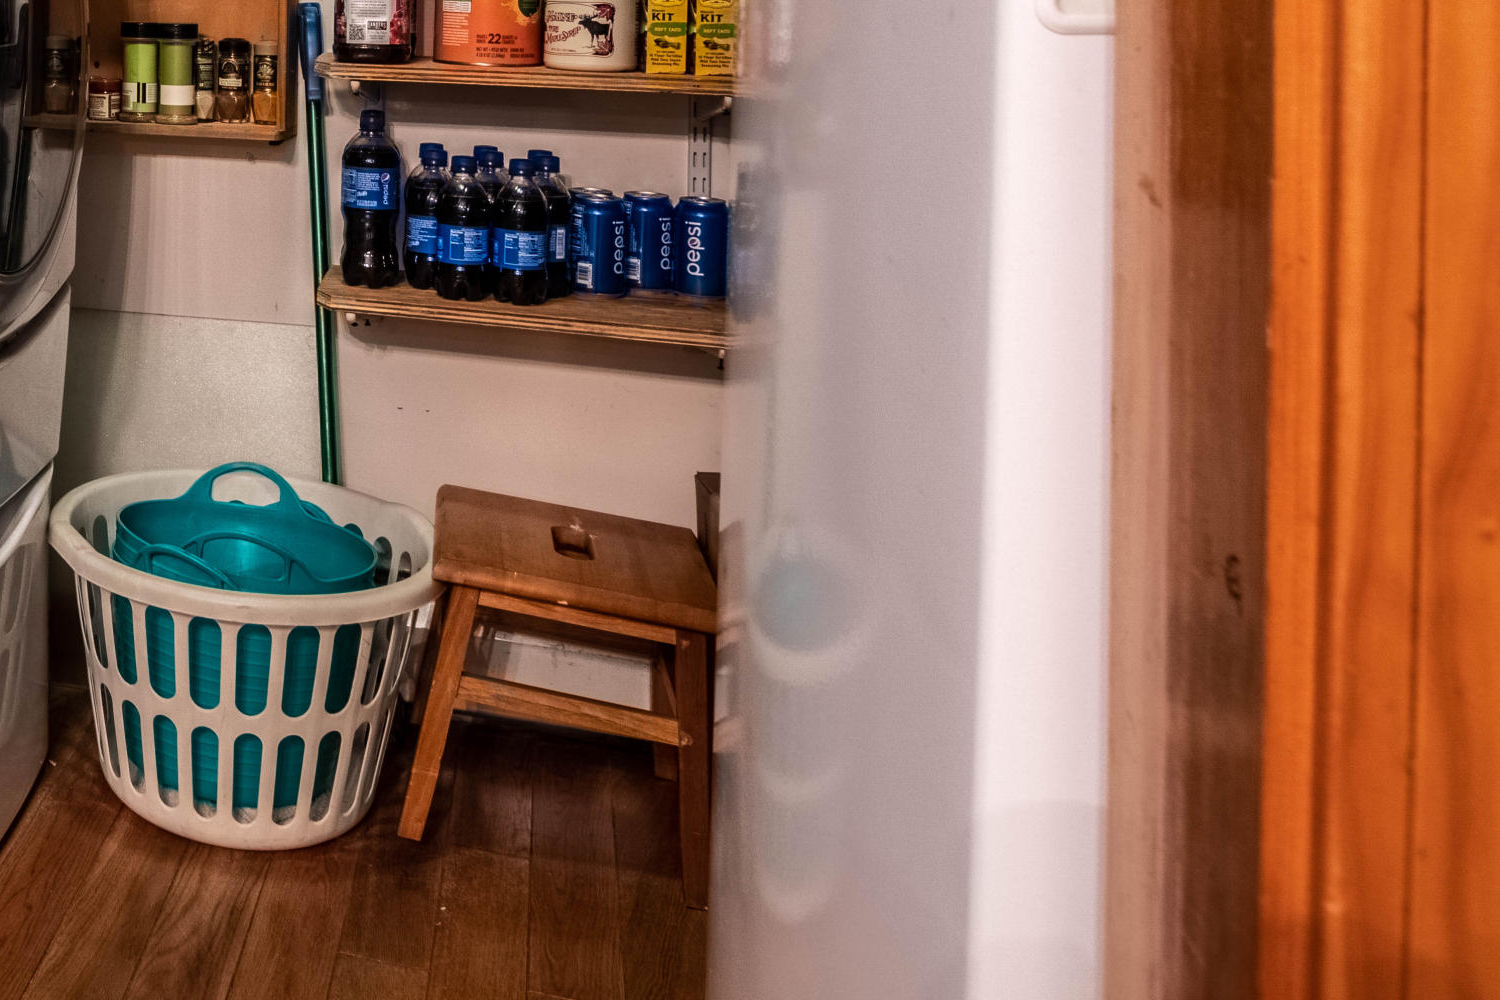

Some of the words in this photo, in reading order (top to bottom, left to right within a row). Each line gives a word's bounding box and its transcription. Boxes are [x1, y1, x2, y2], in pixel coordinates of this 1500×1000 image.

[652, 13, 675, 21] KIT
[700, 14, 723, 22] KIT
[488, 33, 501, 44] 22
[612, 221, 625, 274] pepsi
[659, 218, 671, 270] pepsi
[685, 221, 705, 276] pepsi
